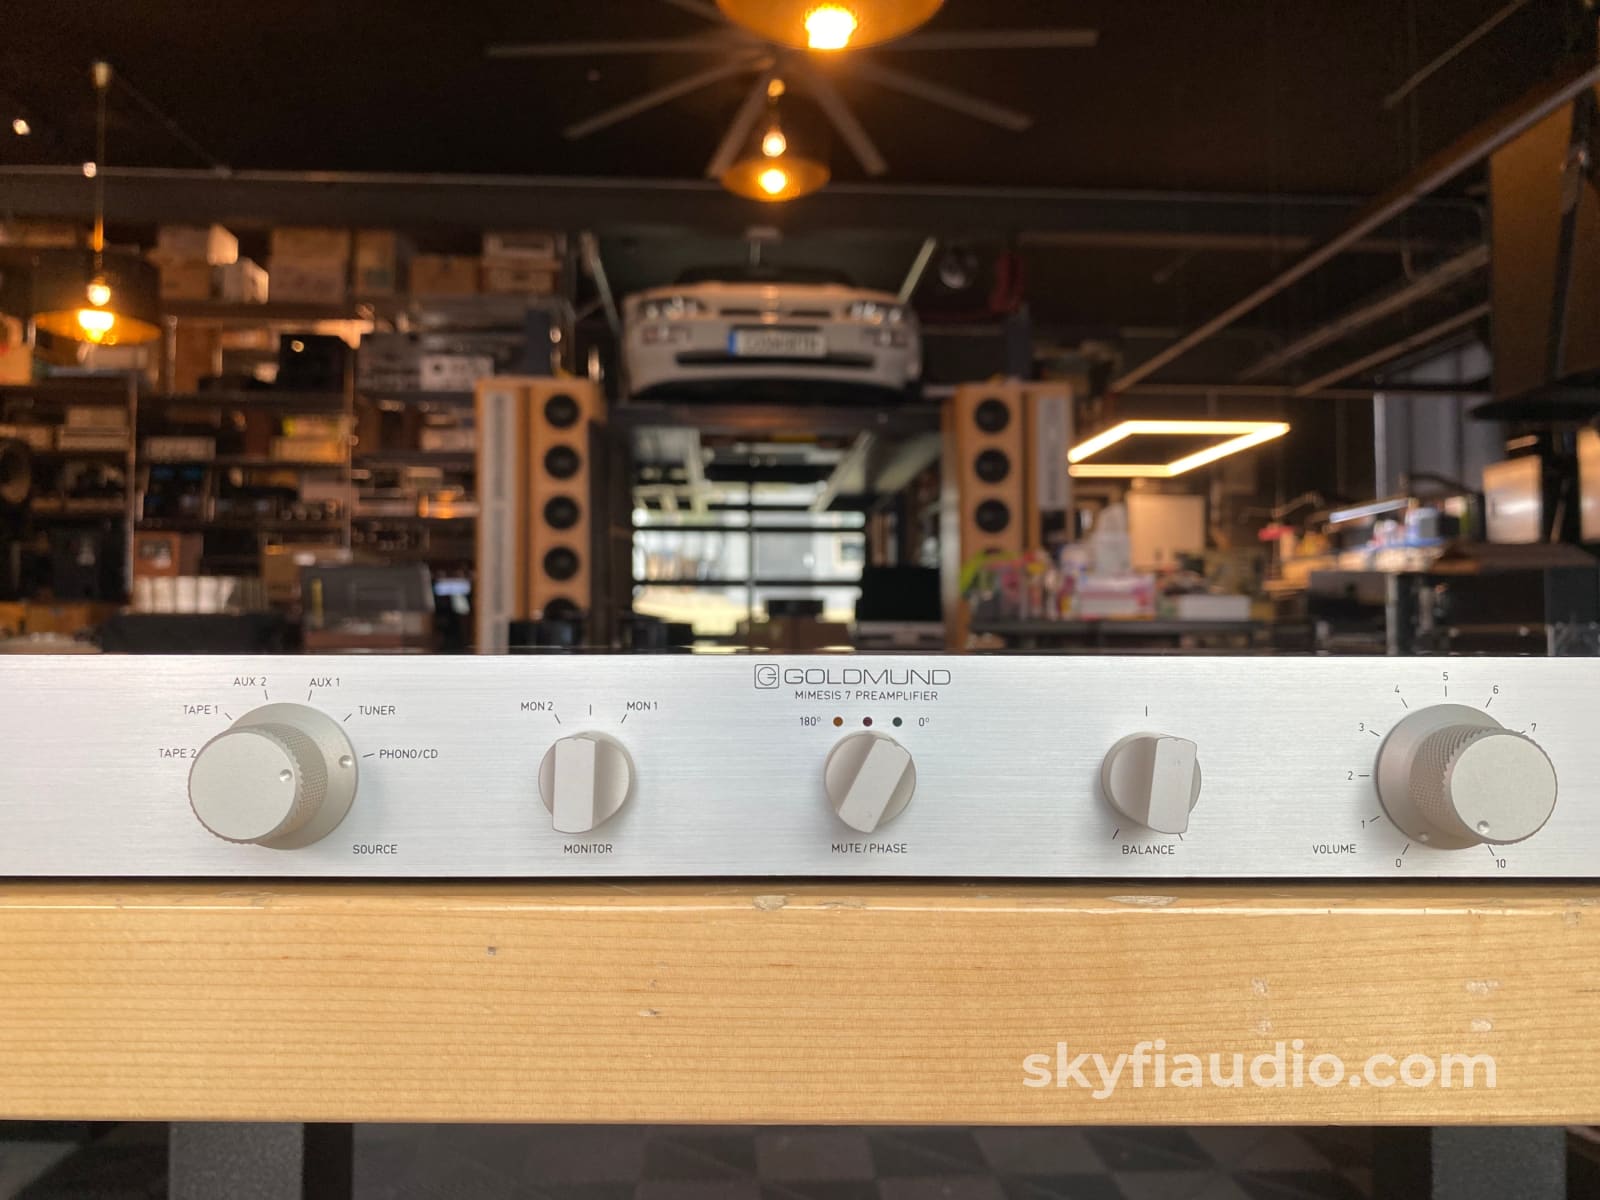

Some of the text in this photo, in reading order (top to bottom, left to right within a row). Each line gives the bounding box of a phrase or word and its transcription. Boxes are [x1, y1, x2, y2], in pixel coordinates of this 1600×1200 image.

[784, 669, 951, 685] GOLDMUND
[1443, 672, 1449, 681] 5
[234, 677, 266, 687] AUX 2
[309, 678, 340, 688] AUX 1
[1394, 685, 1400, 694] 4
[1493, 686, 1499, 694] 6
[795, 691, 938, 700] MIMESIS 7 PREAMPLIFIER
[184, 705, 218, 715] TAPE 1
[521, 702, 553, 711] MON 2
[627, 702, 658, 710] MON 1
[359, 706, 395, 716] TUNER
[1359, 723, 1365, 732] 3
[1531, 723, 1537, 732] 7
[159, 749, 197, 758] TAPE 2
[379, 749, 438, 759] PHONO/CD
[1347, 771, 1353, 781] 2
[1361, 820, 1365, 829] 1
[352, 845, 398, 854] SOURCE
[564, 844, 613, 854] MONITOR
[1122, 845, 1175, 855] BALANCE
[1312, 844, 1357, 854] VOLUME
[1395, 859, 1401, 868] 0
[1496, 859, 1506, 868] 10
